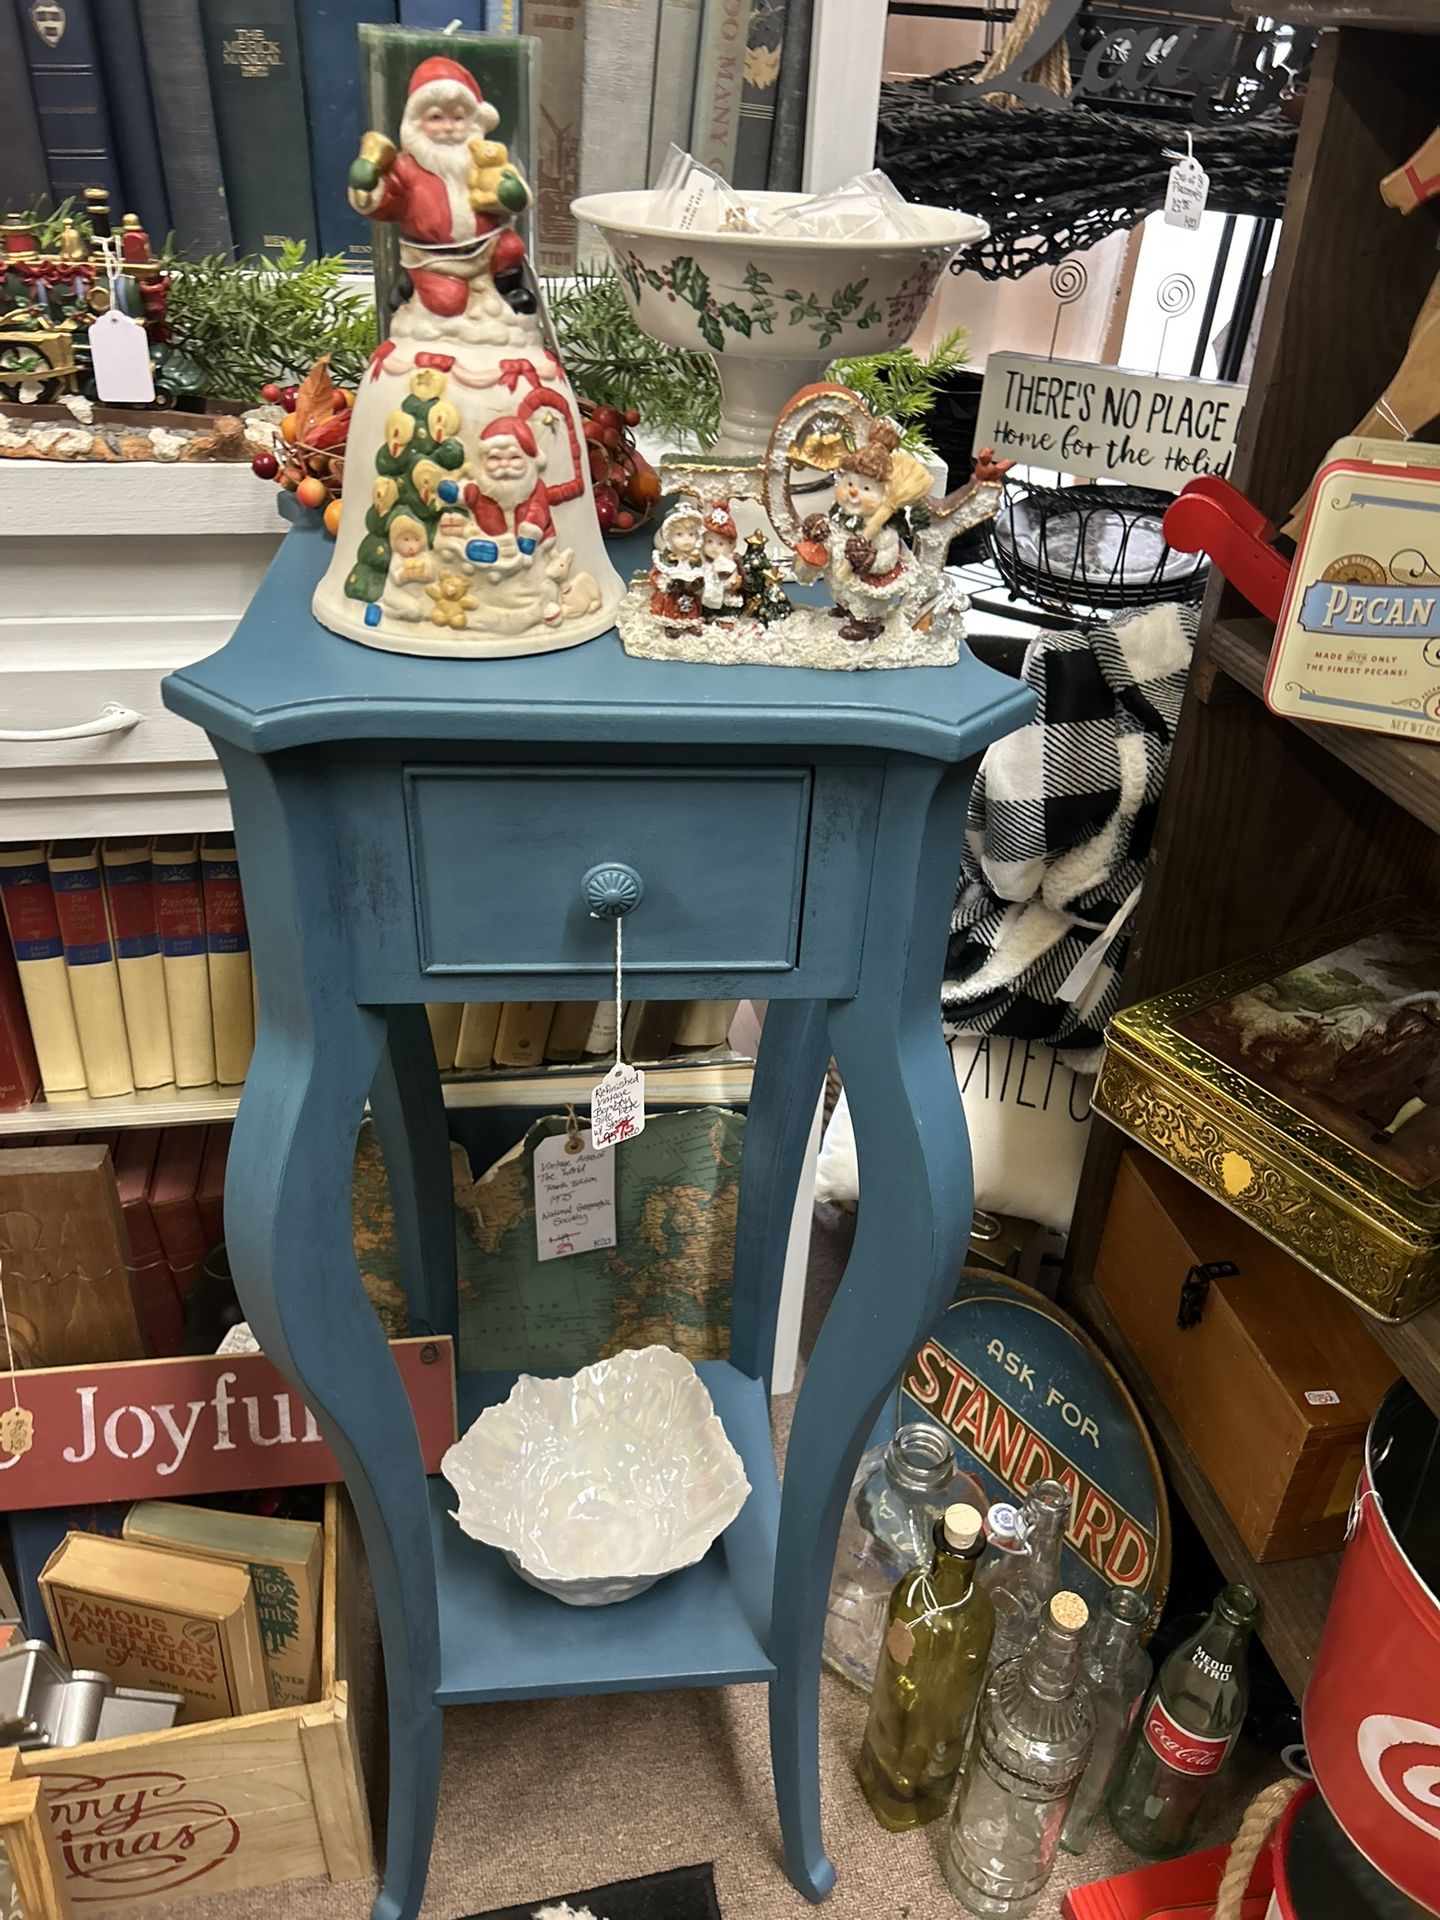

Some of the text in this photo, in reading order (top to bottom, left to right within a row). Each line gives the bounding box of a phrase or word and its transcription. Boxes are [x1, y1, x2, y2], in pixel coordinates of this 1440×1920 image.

[234, 28, 265, 41] THE
[720, 0, 742, 41] OO
[222, 53, 286, 65] MANUAL
[709, 55, 738, 147] MANY
[1005, 370, 1096, 422] THERE'S
[1101, 386, 1141, 429] NO
[1146, 392, 1230, 442] PLACE
[993, 420, 1232, 479] Home for the Holid
[1322, 585, 1437, 628] PECAN
[1306, 663, 1408, 677] THE FINEST PECANS!
[1313, 651, 1342, 661] MADE
[1371, 655, 1398, 664] ONLY
[595, 1072, 640, 1098] Refinished
[597, 1088, 632, 1107] Vintage
[986, 1338, 1100, 1449] ASK FOR
[908, 1341, 1149, 1588] STANDARD
[254, 1578, 287, 1597] lley
[59, 1594, 168, 1633] FAMOUS
[68, 1612, 216, 1658] AMERICAN
[71, 1626, 218, 1670] ATHLETES
[137, 1652, 219, 1684] TODAY
[1191, 1653, 1230, 1681] LITRO
[1195, 1645, 1233, 1673] MEDIO
[183, 1687, 217, 1701] SERIES
[1149, 1719, 1220, 1766] Coca-Cola
